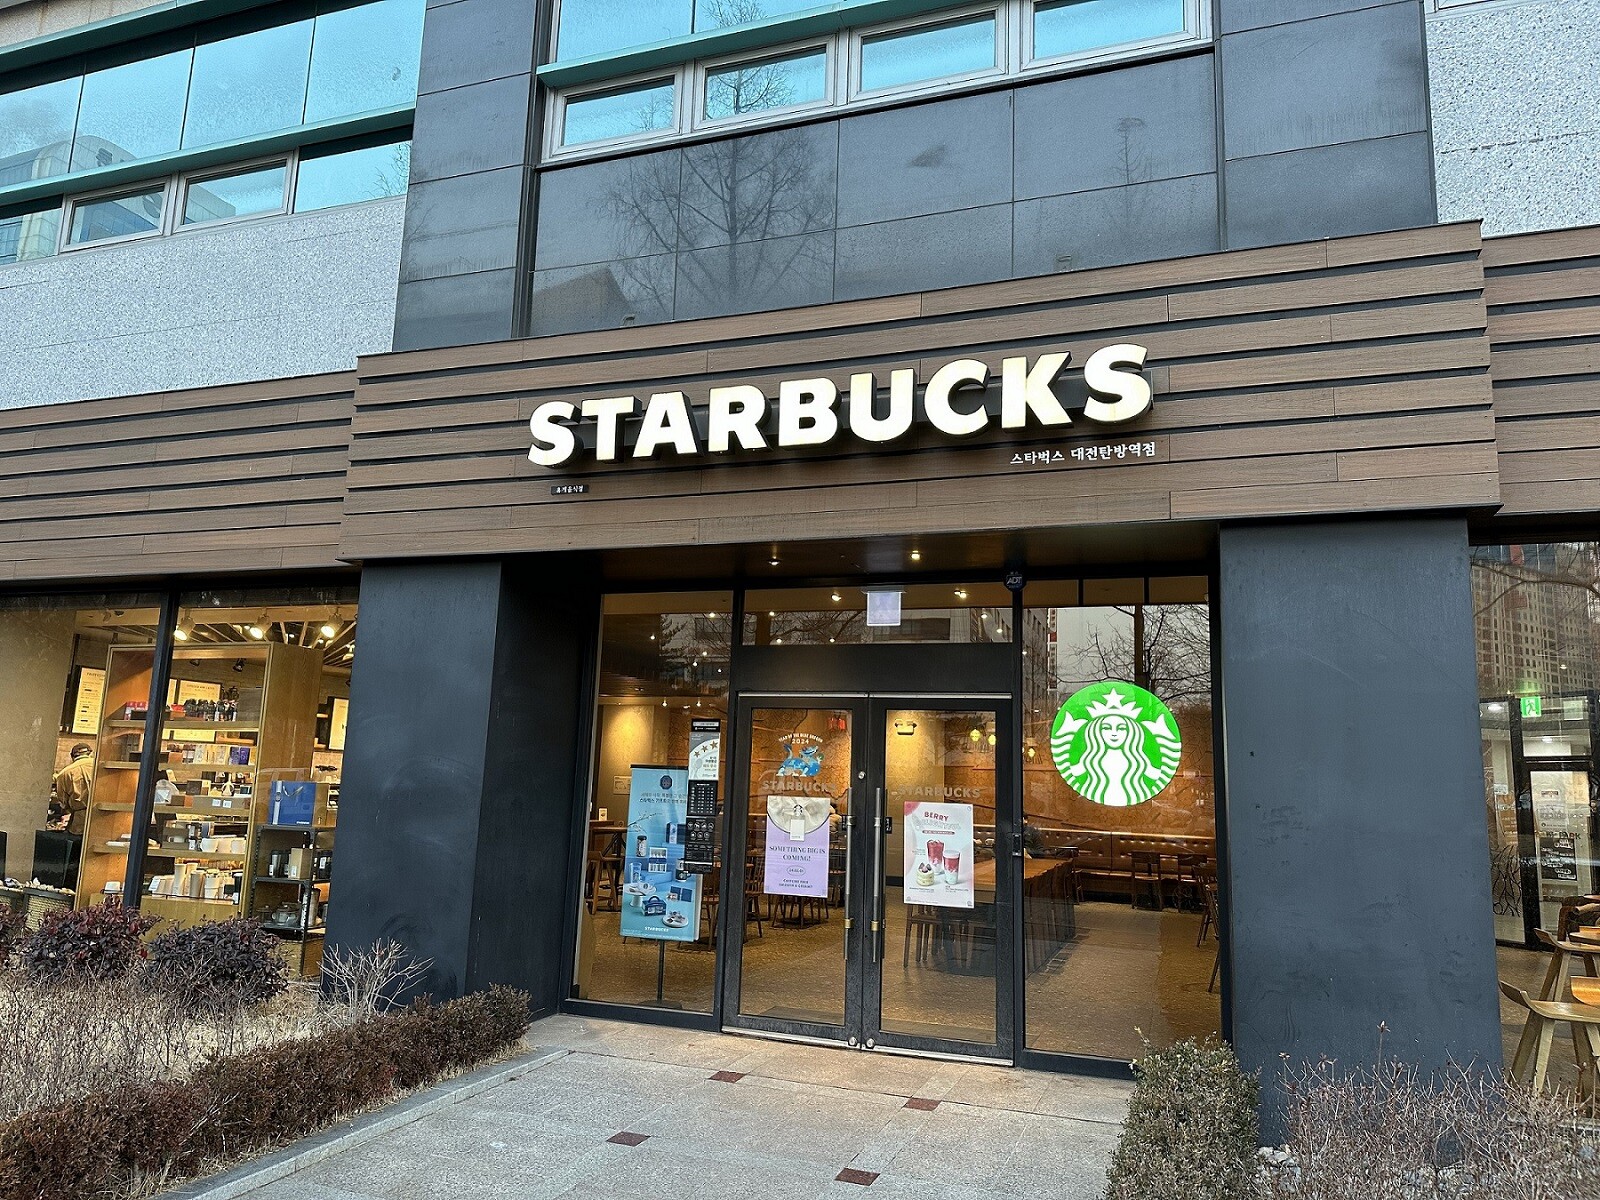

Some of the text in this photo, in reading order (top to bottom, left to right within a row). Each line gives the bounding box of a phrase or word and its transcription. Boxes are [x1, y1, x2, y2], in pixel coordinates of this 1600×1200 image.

[527, 343, 1154, 468] STARBUCKS
[1010, 441, 1156, 465] 스타벅스 대전탄방역점
[897, 784, 981, 798] STARBUCKS
[924, 811, 949, 822] BERRY
[769, 845, 806, 853] SOMETHING
[782, 854, 811, 862] COMING!
